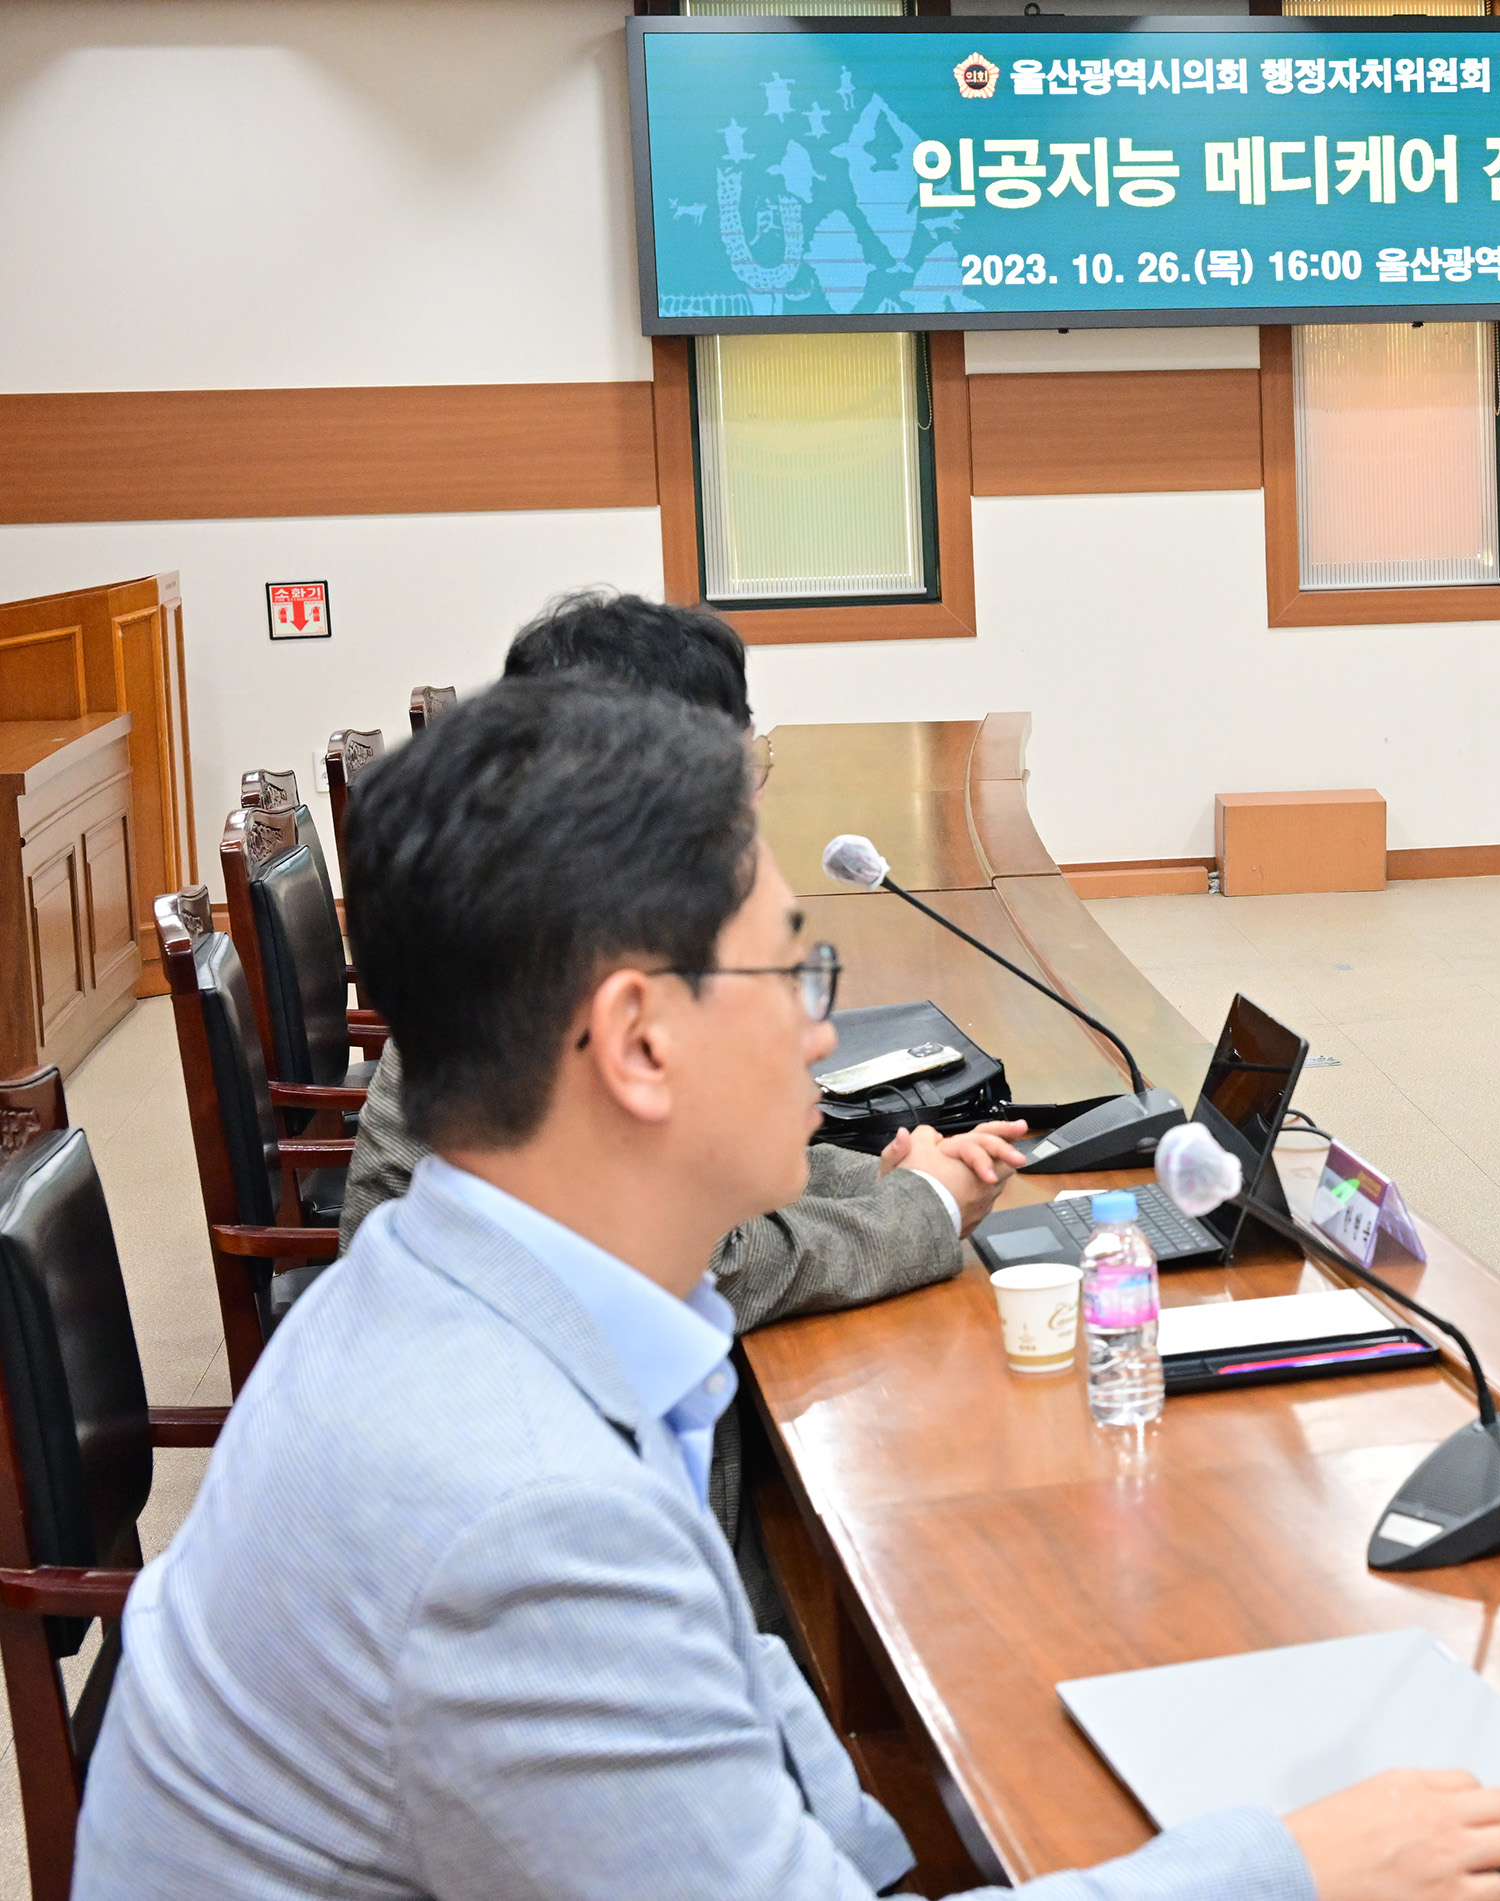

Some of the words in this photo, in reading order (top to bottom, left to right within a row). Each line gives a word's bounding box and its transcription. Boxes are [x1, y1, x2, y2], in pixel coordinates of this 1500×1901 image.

[1010, 58, 1248, 96] 울산광역시의회
[1260, 57, 1491, 95] 행정자치위원회
[912, 137, 1180, 208] 인공지능
[1204, 134, 1458, 206] 메디케어
[961, 253, 1058, 286] 2023.
[1072, 253, 1124, 284] 10.
[1138, 248, 1254, 286] 26.(목)
[1269, 250, 1362, 281] 16:00
[274, 587, 321, 599] 소화기
